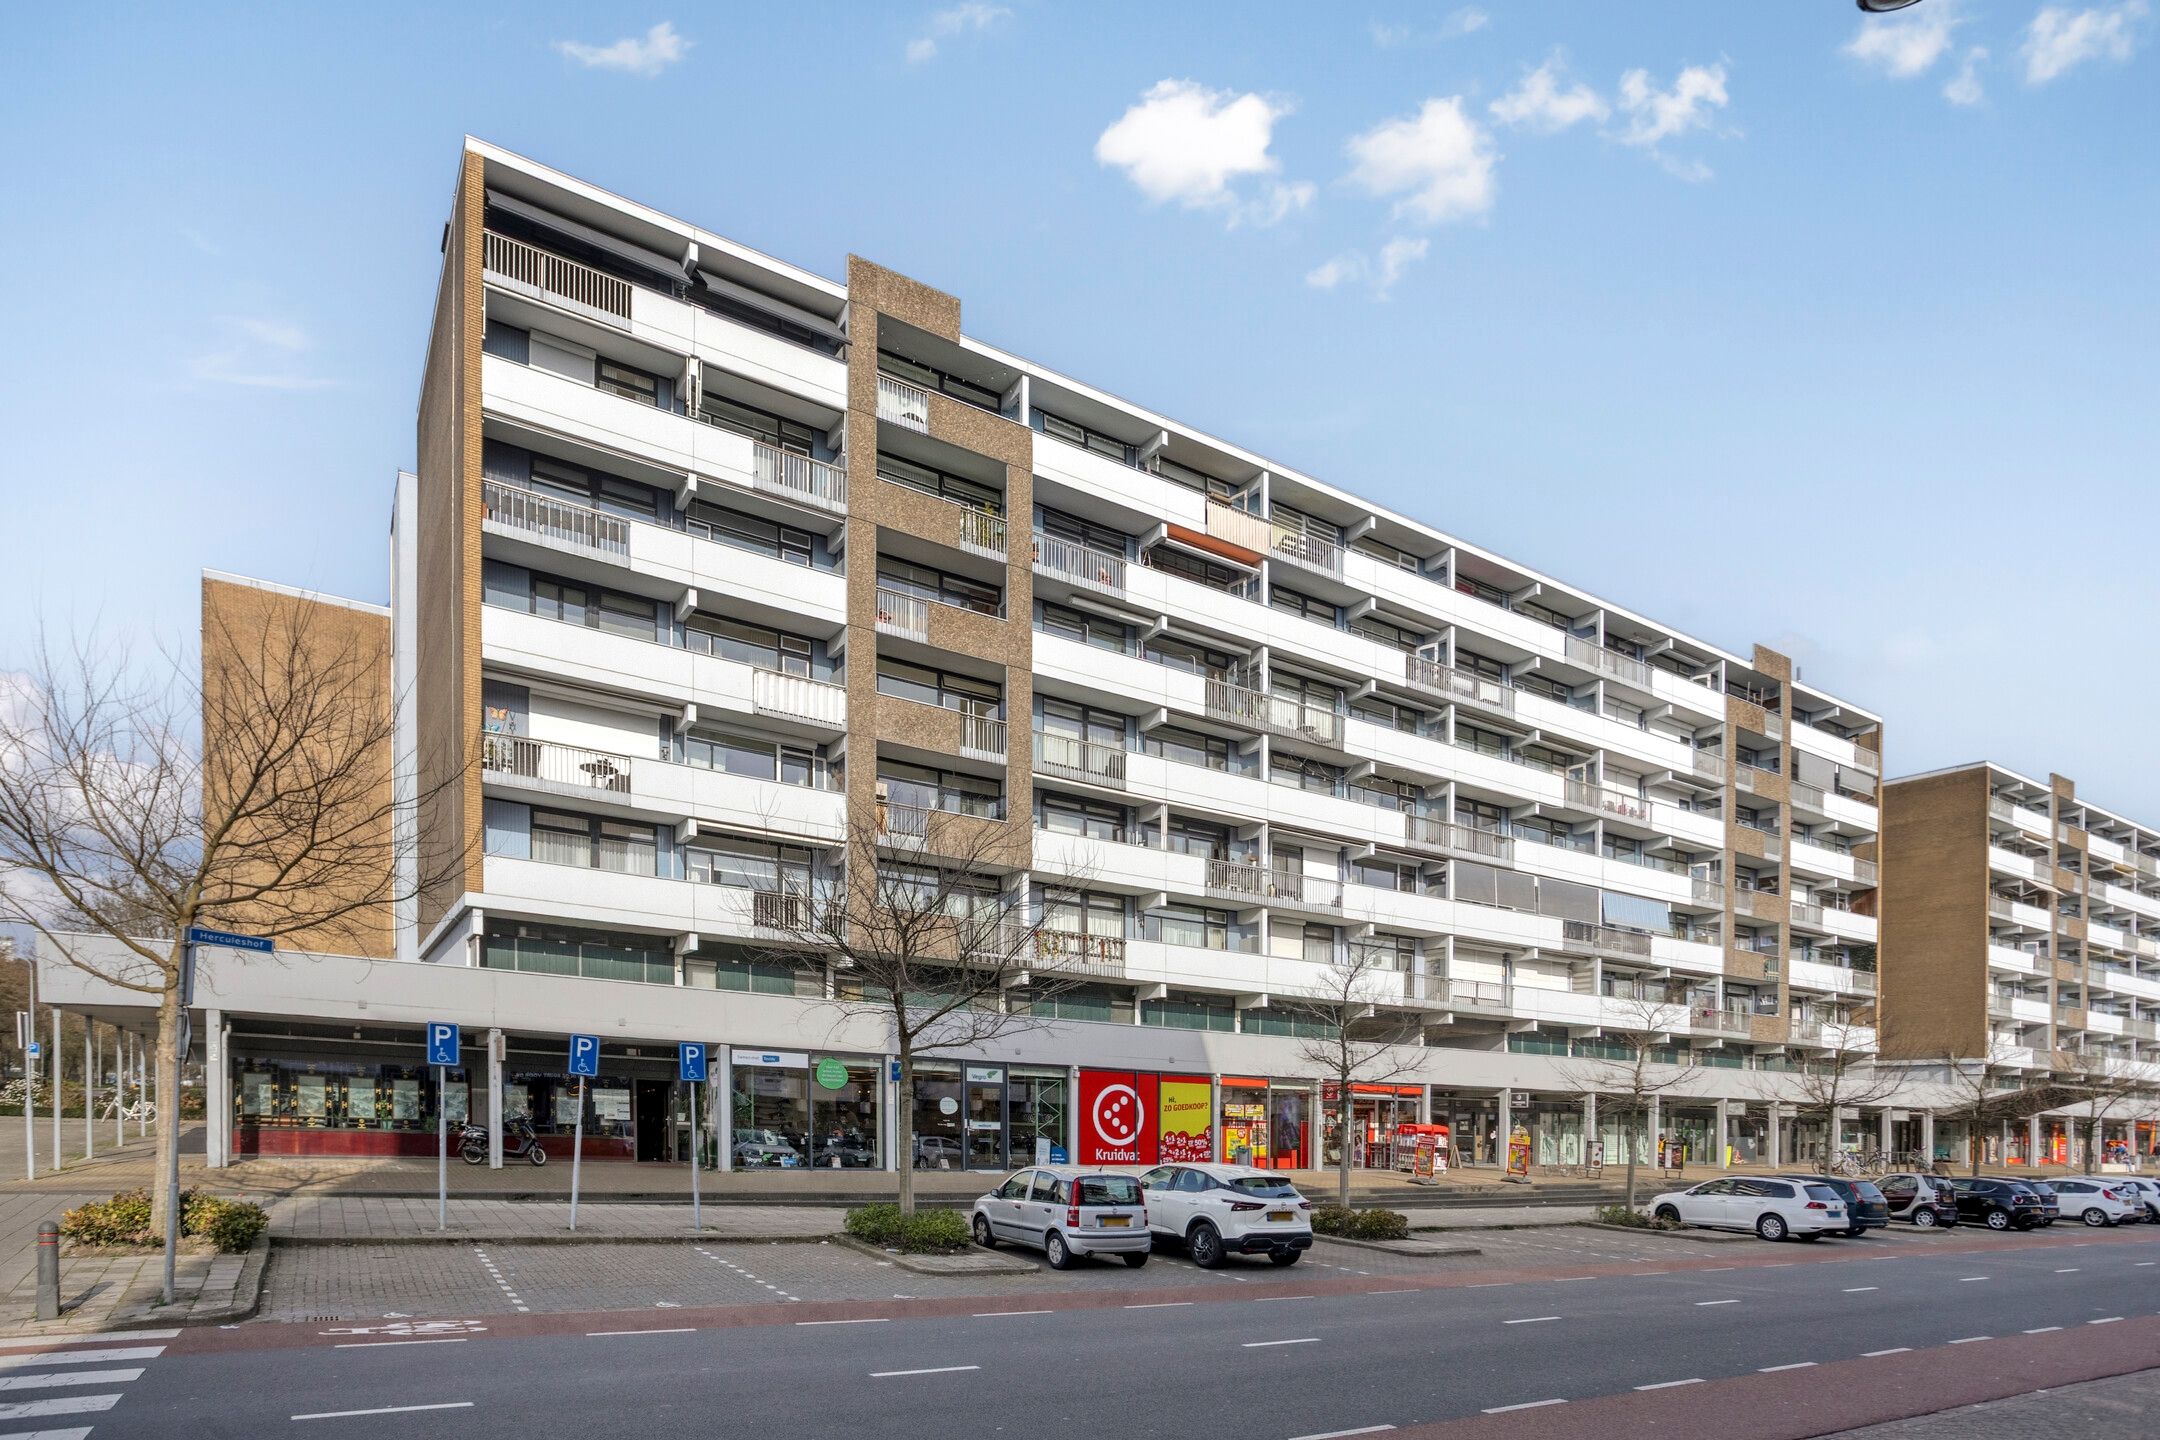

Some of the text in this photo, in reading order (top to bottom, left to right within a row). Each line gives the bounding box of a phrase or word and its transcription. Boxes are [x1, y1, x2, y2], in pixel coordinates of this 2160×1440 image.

[199, 931, 264, 948] Herculeshof
[435, 1025, 452, 1047] P
[577, 1037, 593, 1058] P
[686, 1046, 700, 1065] P
[1163, 1102, 1208, 1112] ZO GOEDKOOP?
